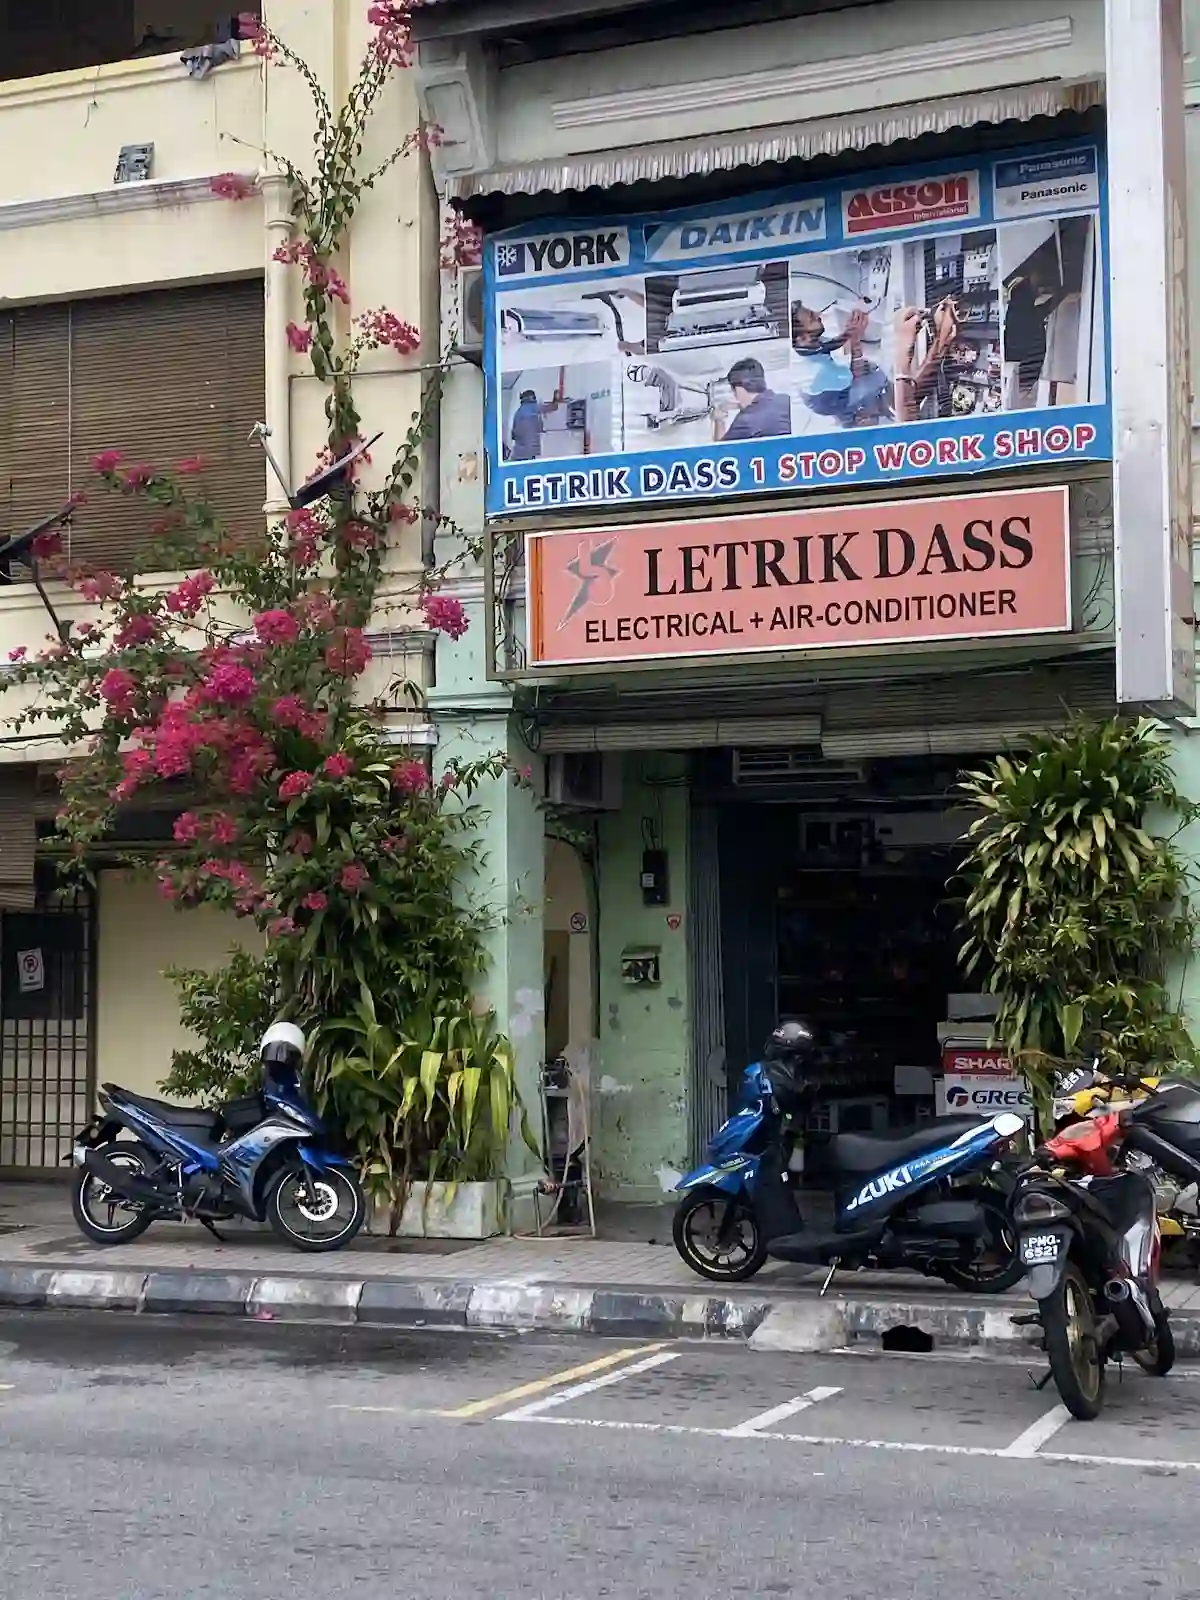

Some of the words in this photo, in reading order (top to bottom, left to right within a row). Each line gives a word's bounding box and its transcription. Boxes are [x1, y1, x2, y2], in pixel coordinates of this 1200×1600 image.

[1021, 182, 1088, 200] Panasonic
[680, 206, 823, 250] DAIKIN
[526, 232, 621, 272] YORK
[506, 468, 631, 505] LETRIK
[642, 459, 738, 493] DASS
[751, 457, 766, 482] 1
[780, 449, 864, 480] STOP
[876, 434, 984, 468] WORK
[995, 424, 1096, 457] SHOP
[643, 531, 862, 598] LETRIK
[874, 516, 1034, 579] DASS
[585, 612, 746, 644] ELECTRICAL
[769, 589, 1018, 630] AIR-CONDITIONER
[954, 1057, 1014, 1070] SHAR
[846, 1165, 913, 1211] ZUKI
